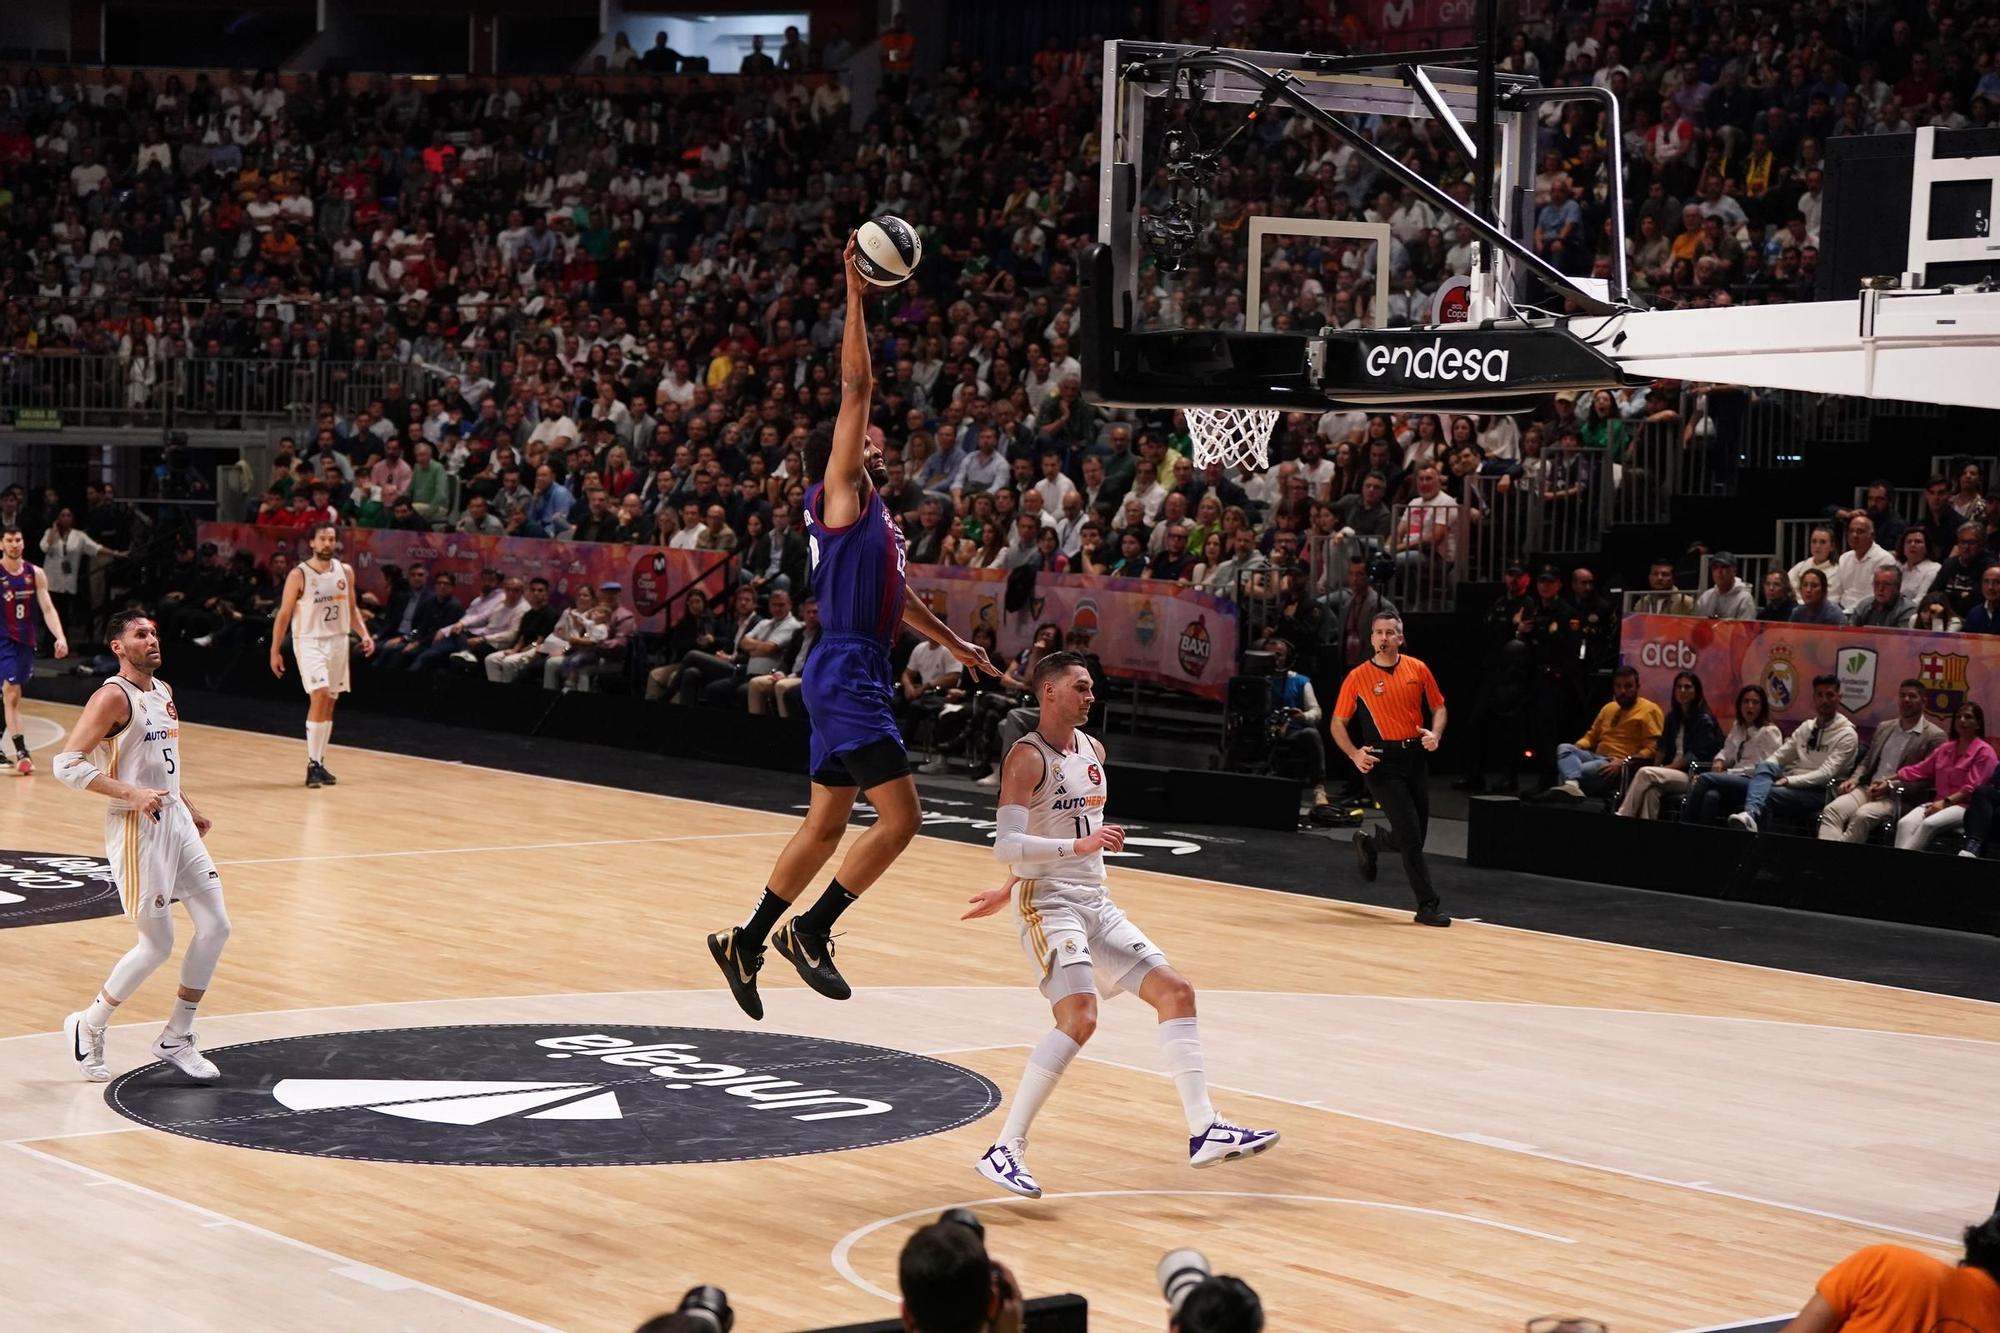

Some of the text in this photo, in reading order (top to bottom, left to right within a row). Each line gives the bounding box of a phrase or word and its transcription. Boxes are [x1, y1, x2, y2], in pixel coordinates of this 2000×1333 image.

[1366, 337, 1509, 382] endesa
[16, 604, 24, 619] 8
[323, 605, 339, 621] 23
[1180, 635, 1210, 657] BAXI
[1643, 640, 1696, 669] acb
[163, 748, 175, 774] 5
[1072, 814, 1090, 839] 11
[534, 1034, 893, 1122] Unicaja
